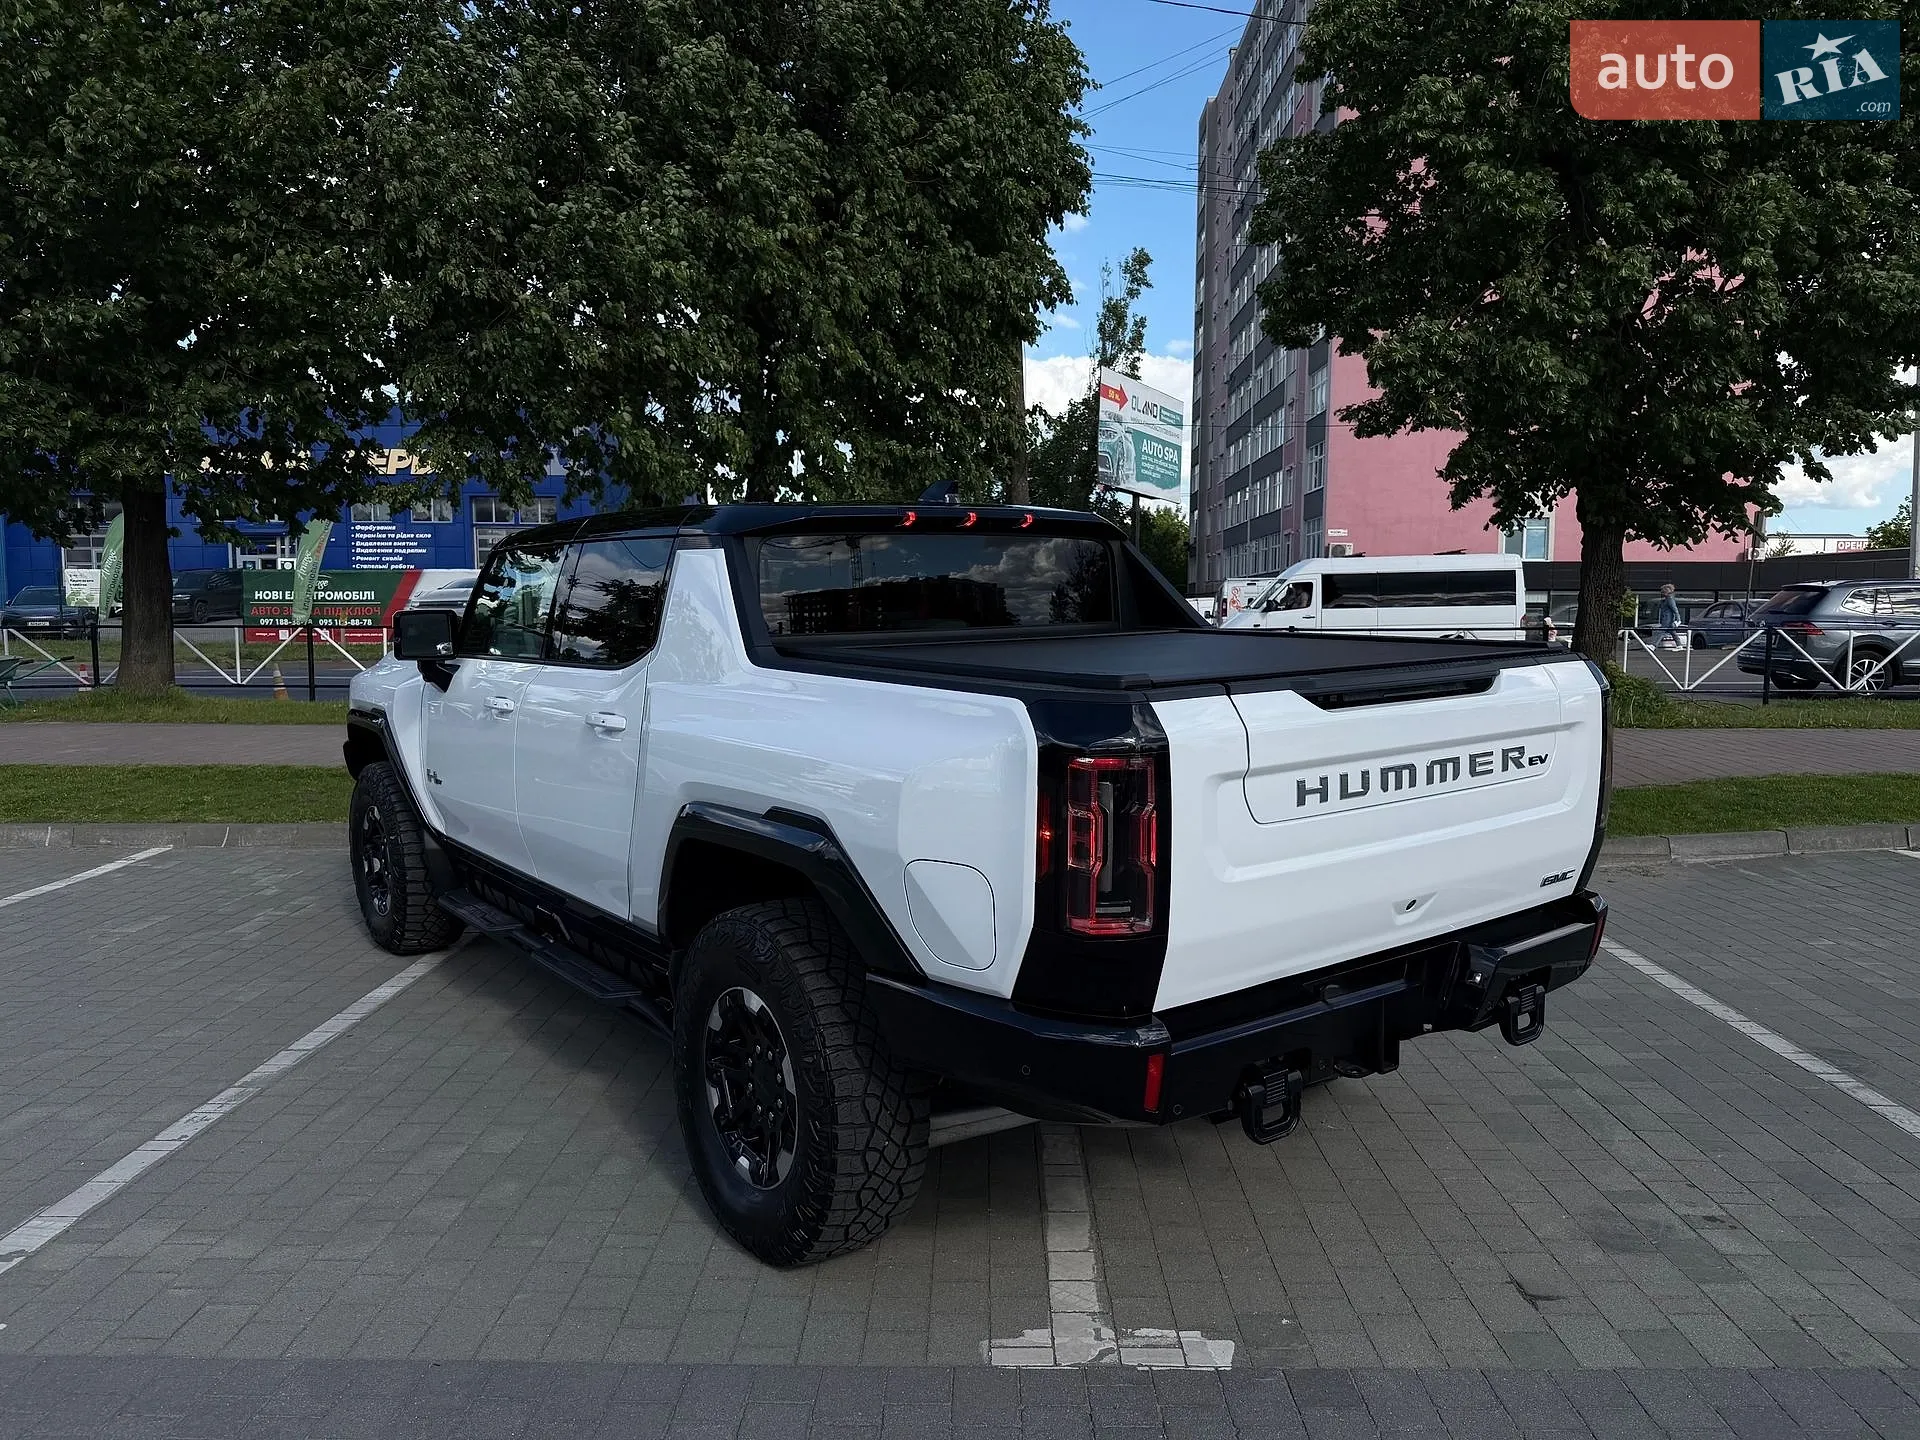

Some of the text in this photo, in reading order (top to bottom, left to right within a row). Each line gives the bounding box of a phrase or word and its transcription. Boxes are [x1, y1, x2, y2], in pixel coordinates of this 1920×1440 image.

[1142, 439, 1163, 458] AUTO
[1164, 446, 1178, 464] SPA
[254, 591, 283, 600] НОВІ
[250, 606, 281, 616] АВТО
[345, 606, 381, 616] КЛЮЧ
[260, 618, 274, 626] 097
[318, 618, 333, 626] 095
[1296, 745, 1549, 808] HUMMER EV
[1540, 869, 1576, 887] GMC
